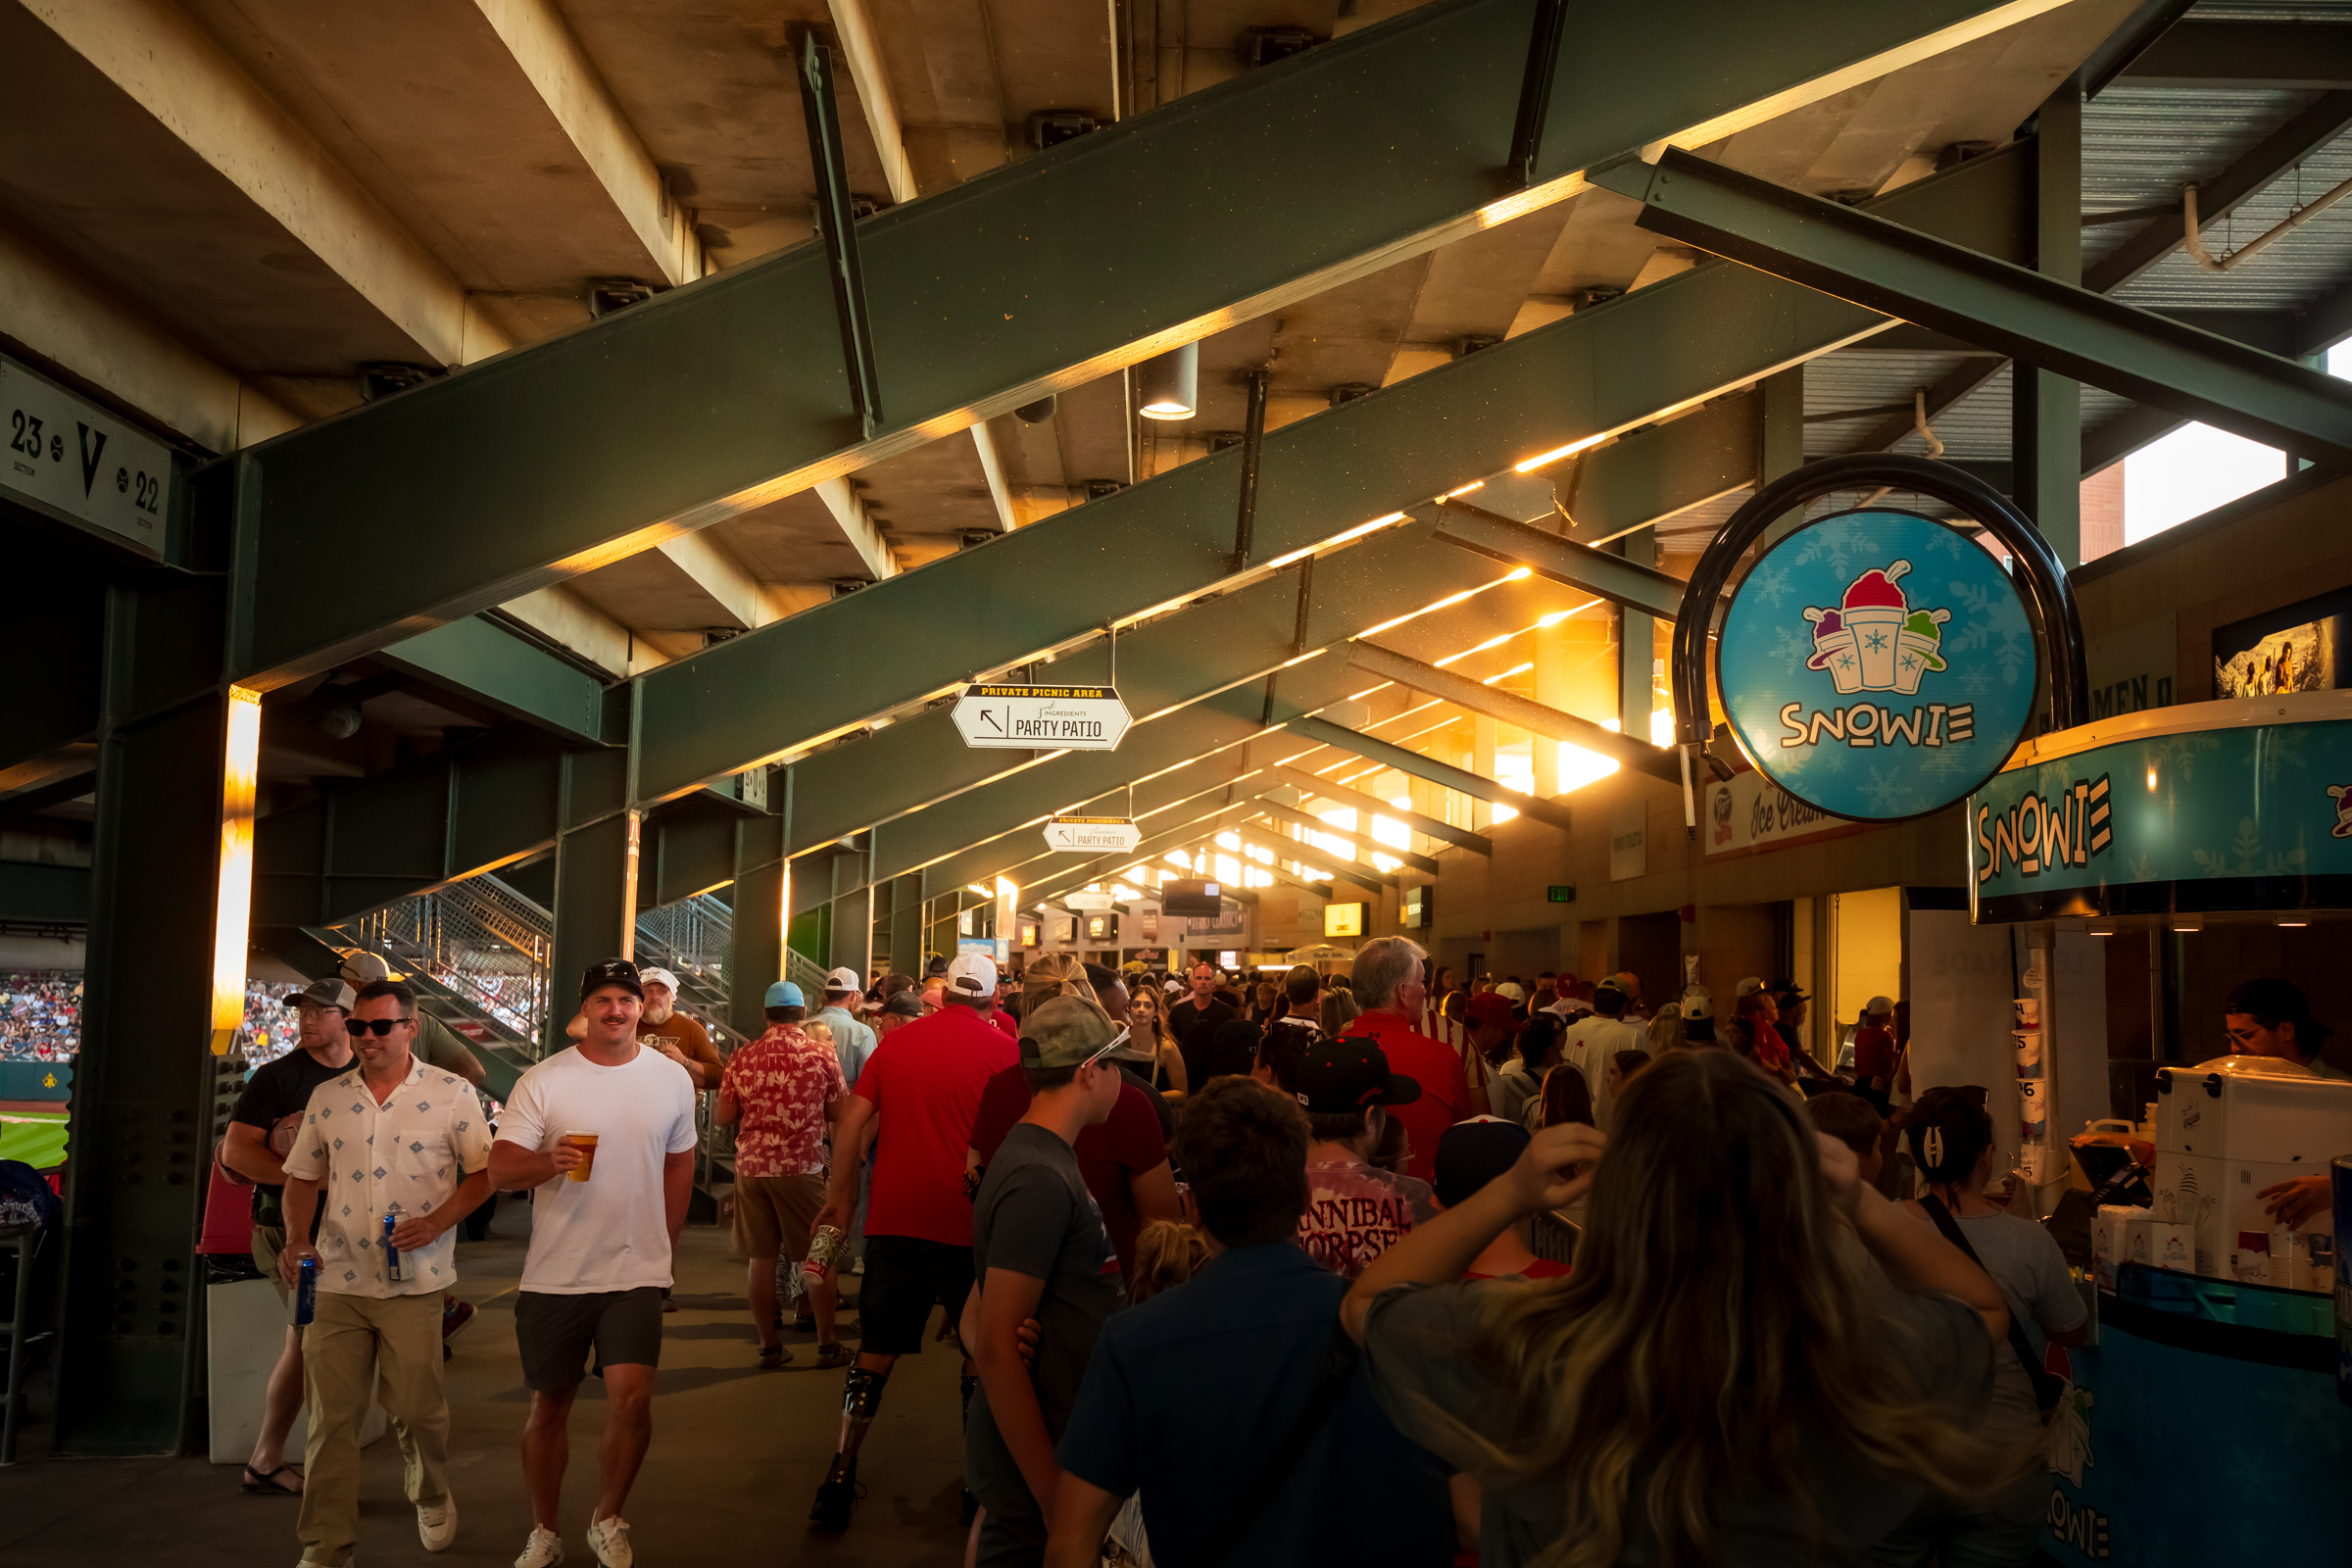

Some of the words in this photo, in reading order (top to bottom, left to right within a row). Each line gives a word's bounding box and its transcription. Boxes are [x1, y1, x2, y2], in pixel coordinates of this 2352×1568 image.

[10, 409, 44, 460] 23
[76, 420, 108, 501] V
[135, 470, 159, 515] 22
[14, 461, 35, 477] SECTION
[981, 687, 1029, 697] PRIVATE
[1032, 688, 1070, 698] PICNIC
[1073, 689, 1102, 698] AREA
[1015, 719, 1058, 737] PARTY
[1062, 720, 1102, 737] PATIO
[1780, 702, 1976, 749] SNOWIE
[1750, 792, 1775, 840] Ice
[1978, 771, 2113, 883] SNOWIE
[1078, 835, 1102, 845] PARTY
[1102, 836, 1125, 846] PATIO
[1551, 887, 1568, 901] EXIT
[2046, 1489, 2111, 1562] OWIE
